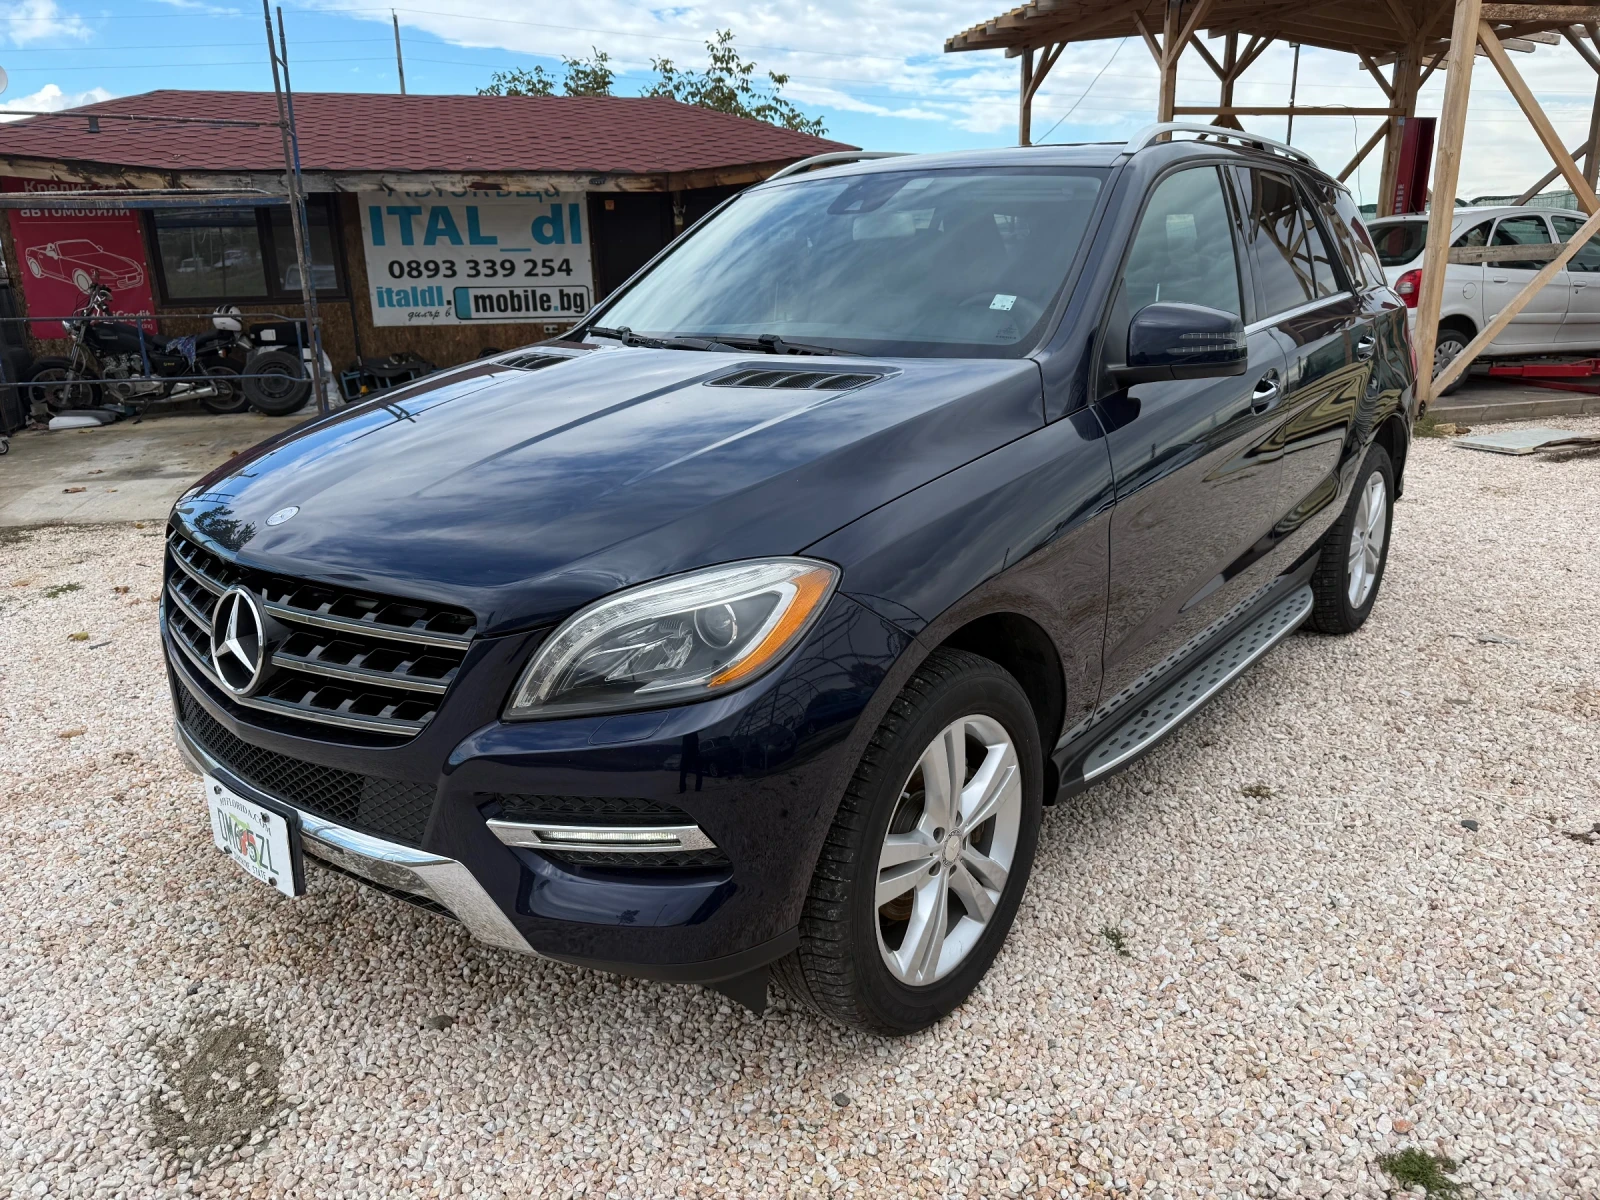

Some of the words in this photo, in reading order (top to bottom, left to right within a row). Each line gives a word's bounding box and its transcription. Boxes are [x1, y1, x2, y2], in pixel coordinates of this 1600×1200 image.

[388, 259, 457, 279] 0893
[465, 258, 516, 278] 339
[523, 257, 573, 277] 254
[473, 289, 585, 314] mobile.bg
